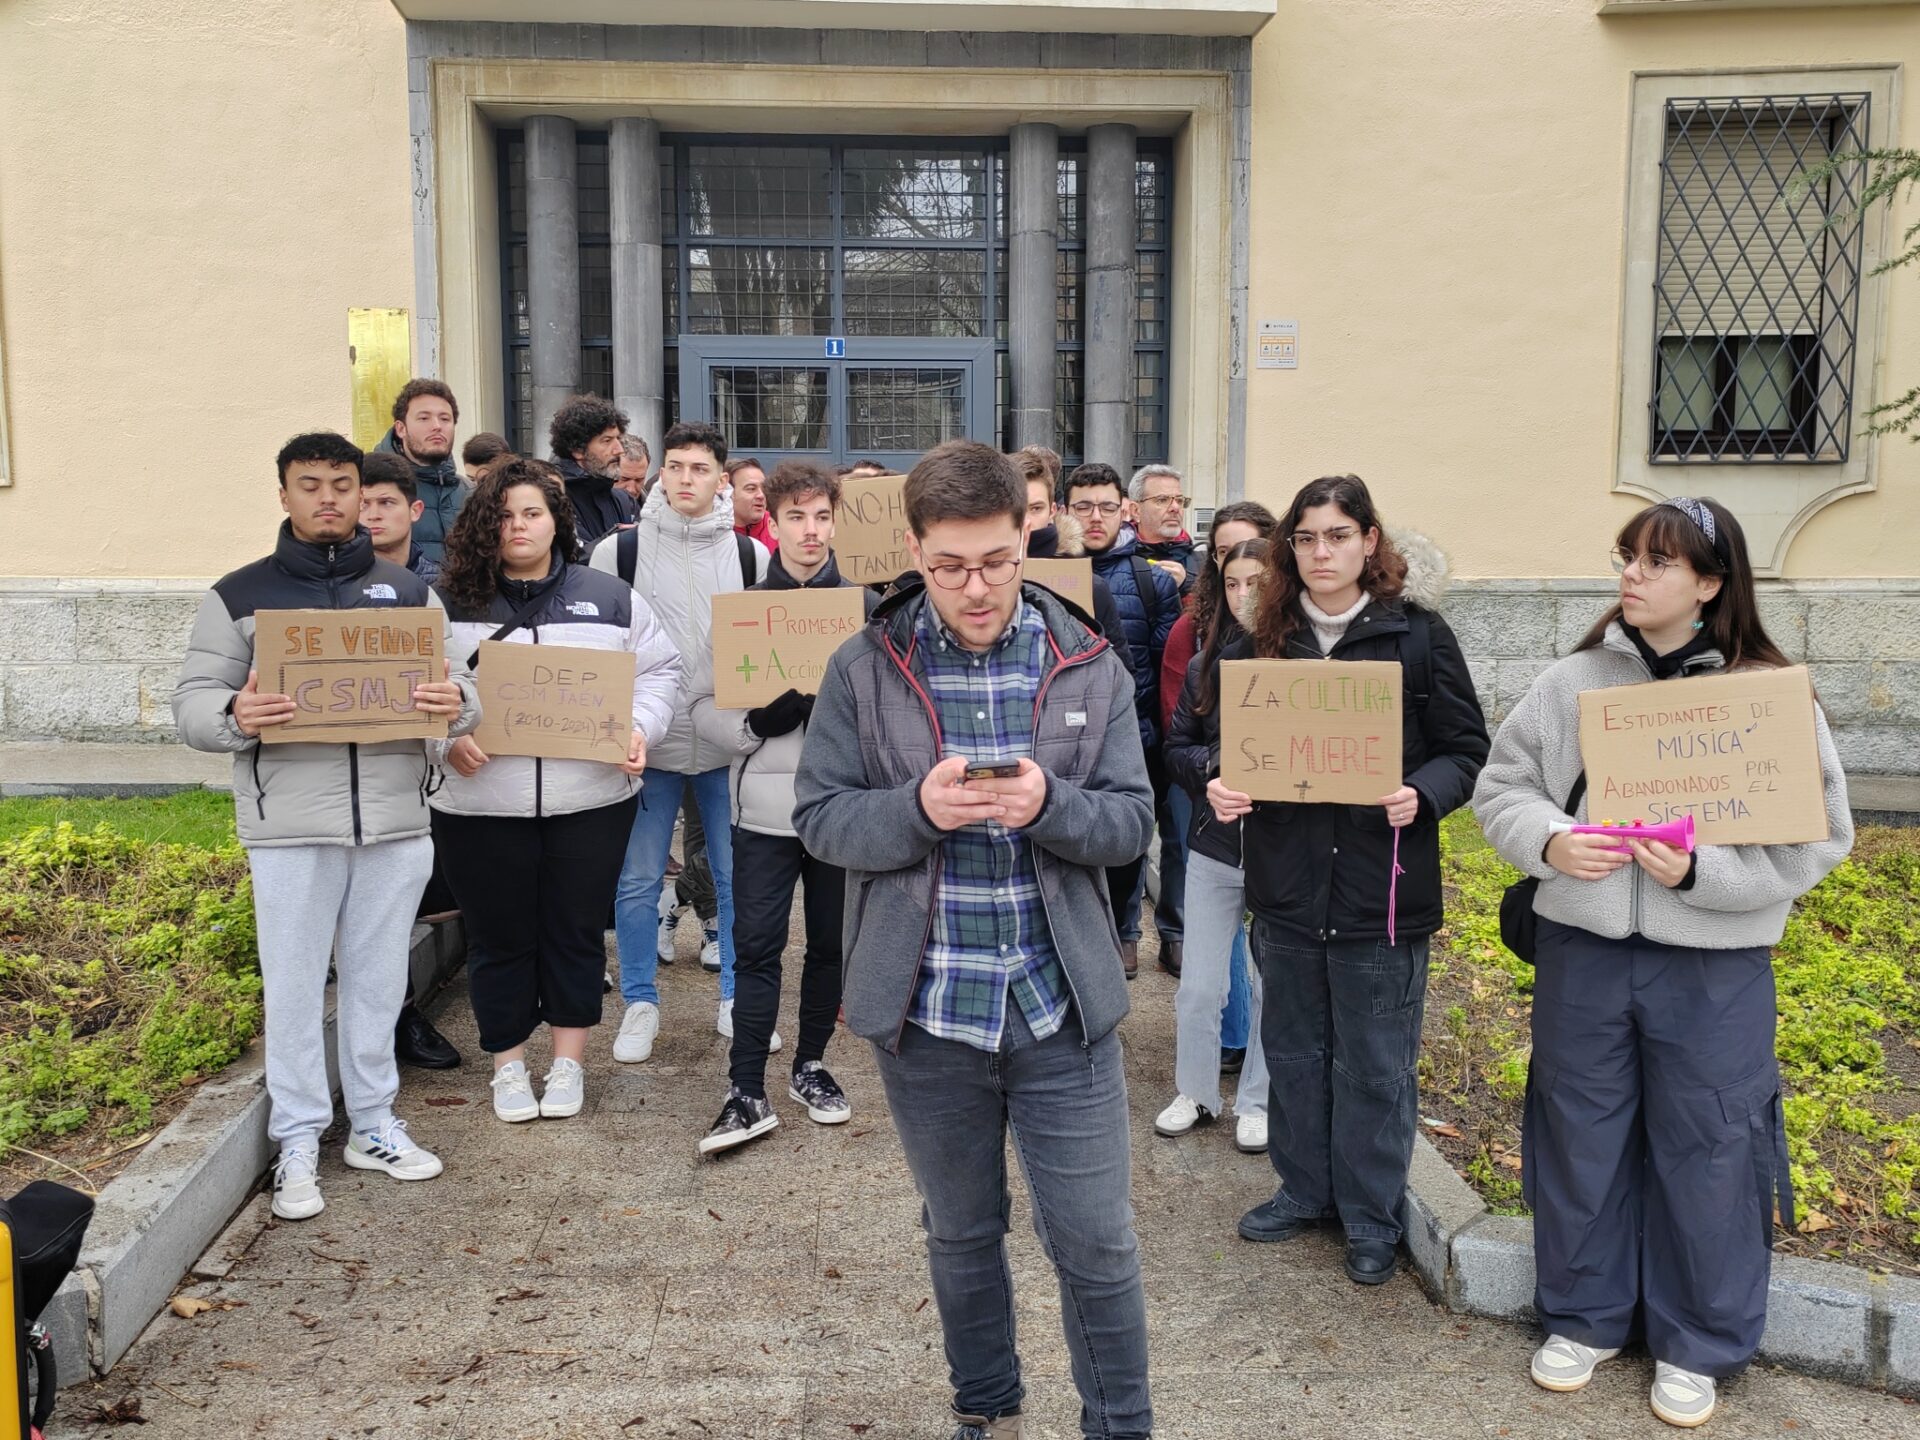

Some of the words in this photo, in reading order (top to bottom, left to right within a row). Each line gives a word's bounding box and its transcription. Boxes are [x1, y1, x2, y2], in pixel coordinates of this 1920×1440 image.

[831, 340, 838, 354] 1
[842, 491, 882, 525] NO
[767, 605, 855, 635] PROMESAS
[285, 626, 324, 656] SE
[341, 625, 434, 656] VENDE
[296, 670, 425, 714] CSMJ
[497, 683, 546, 701] CSM
[1239, 673, 1280, 709] LA
[1288, 677, 1393, 713] CULTURA
[1603, 704, 1730, 731] ESTUDIANTES
[1750, 700, 1776, 719] DE
[1240, 738, 1279, 771] SE
[1289, 735, 1384, 775] MUERE
[1604, 775, 1730, 799] ABANDONADOS
[1746, 759, 1781, 777] POR
[1748, 780, 1779, 793] EL
